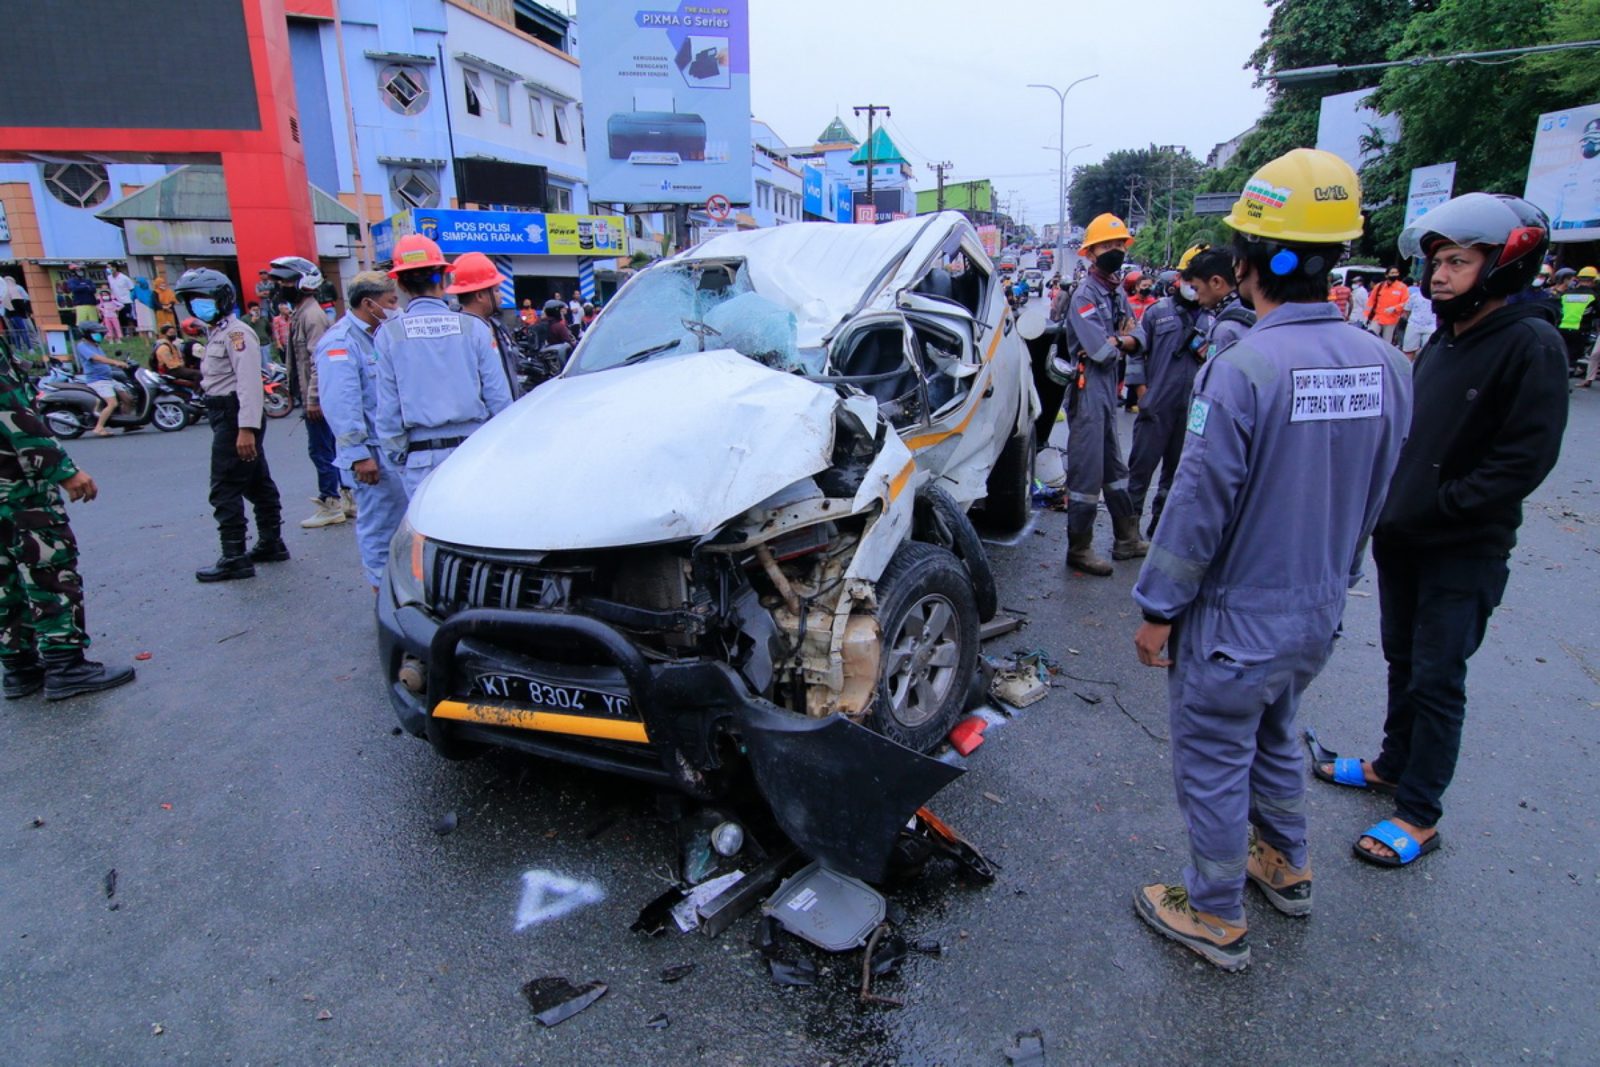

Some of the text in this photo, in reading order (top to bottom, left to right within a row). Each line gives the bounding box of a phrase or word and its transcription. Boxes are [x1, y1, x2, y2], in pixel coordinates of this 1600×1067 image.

[643, 14, 729, 27] PIXMA G Series
[454, 222, 511, 233] POS POLISI
[442, 231, 524, 243] SIMPANG RAPAK
[1348, 392, 1380, 413] PERDANA
[482, 676, 510, 697] KT
[529, 682, 584, 710] 8304
